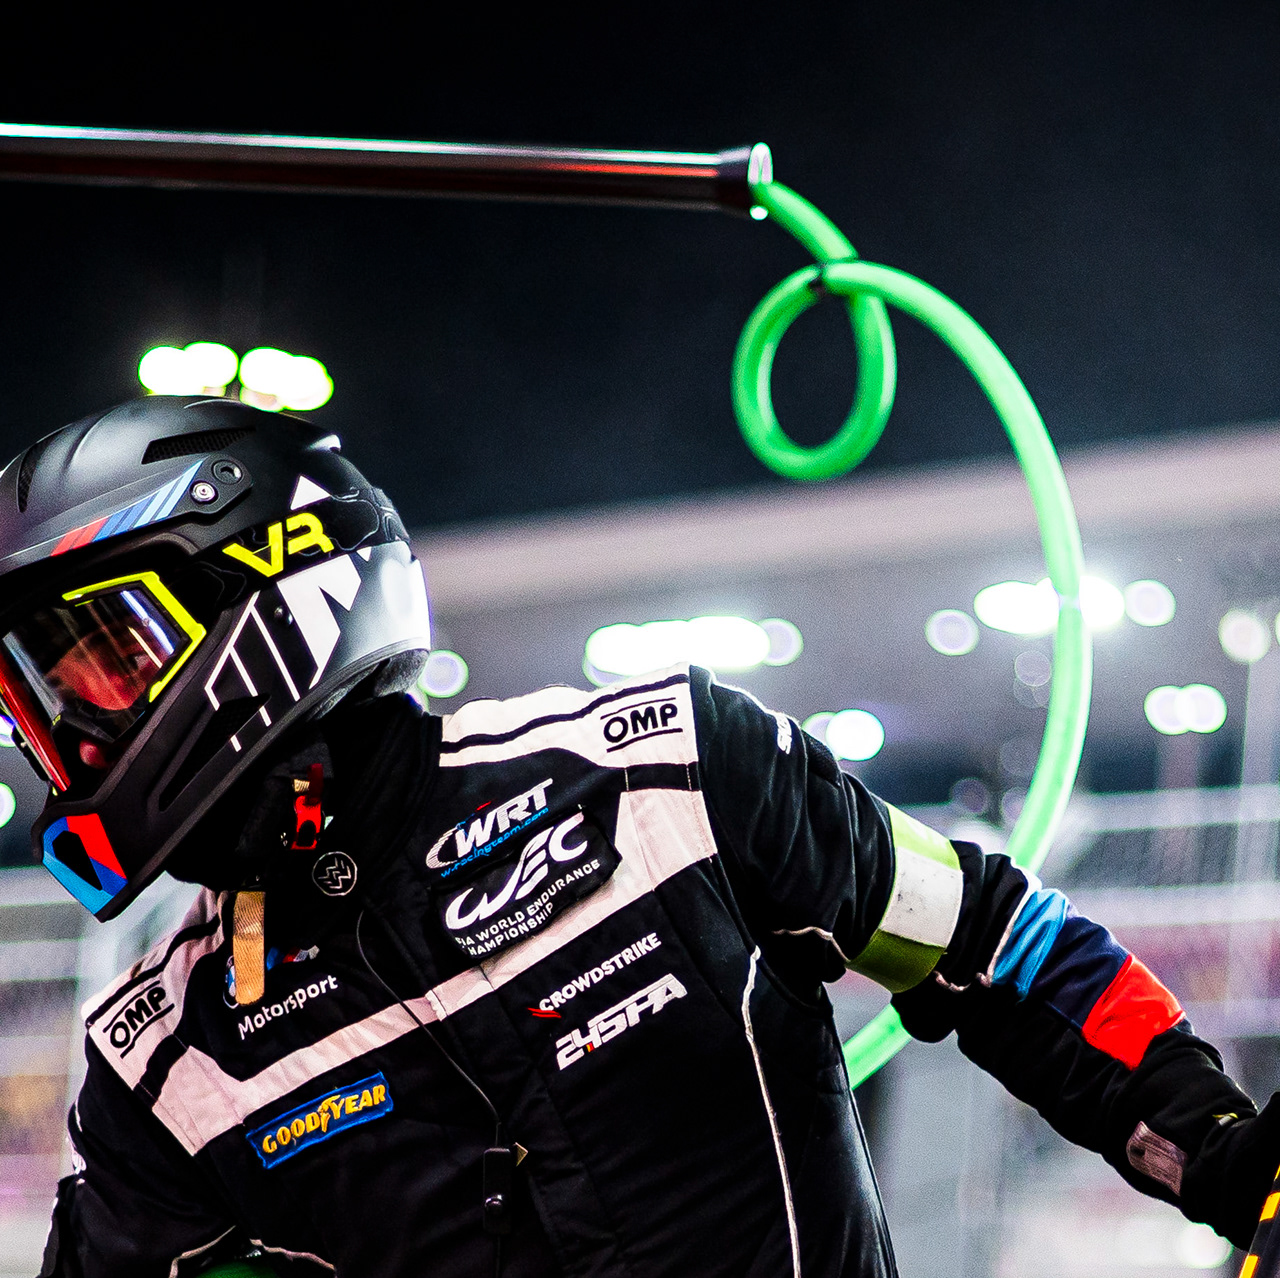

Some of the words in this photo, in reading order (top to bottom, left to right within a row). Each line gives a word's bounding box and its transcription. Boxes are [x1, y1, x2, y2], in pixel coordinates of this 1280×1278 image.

[603, 702, 679, 744] OMP
[455, 778, 554, 858] WRT
[445, 811, 588, 930] WEC
[476, 911, 526, 941] WORLD
[527, 859, 601, 916] ENDURANCE
[468, 902, 554, 956] HAMPIONSHIP
[237, 974, 338, 1040] Motorsport
[539, 932, 662, 1012] CROWDSTRIKE
[110, 987, 167, 1049] OMP
[262, 1084, 387, 1154] GOODYEAR
